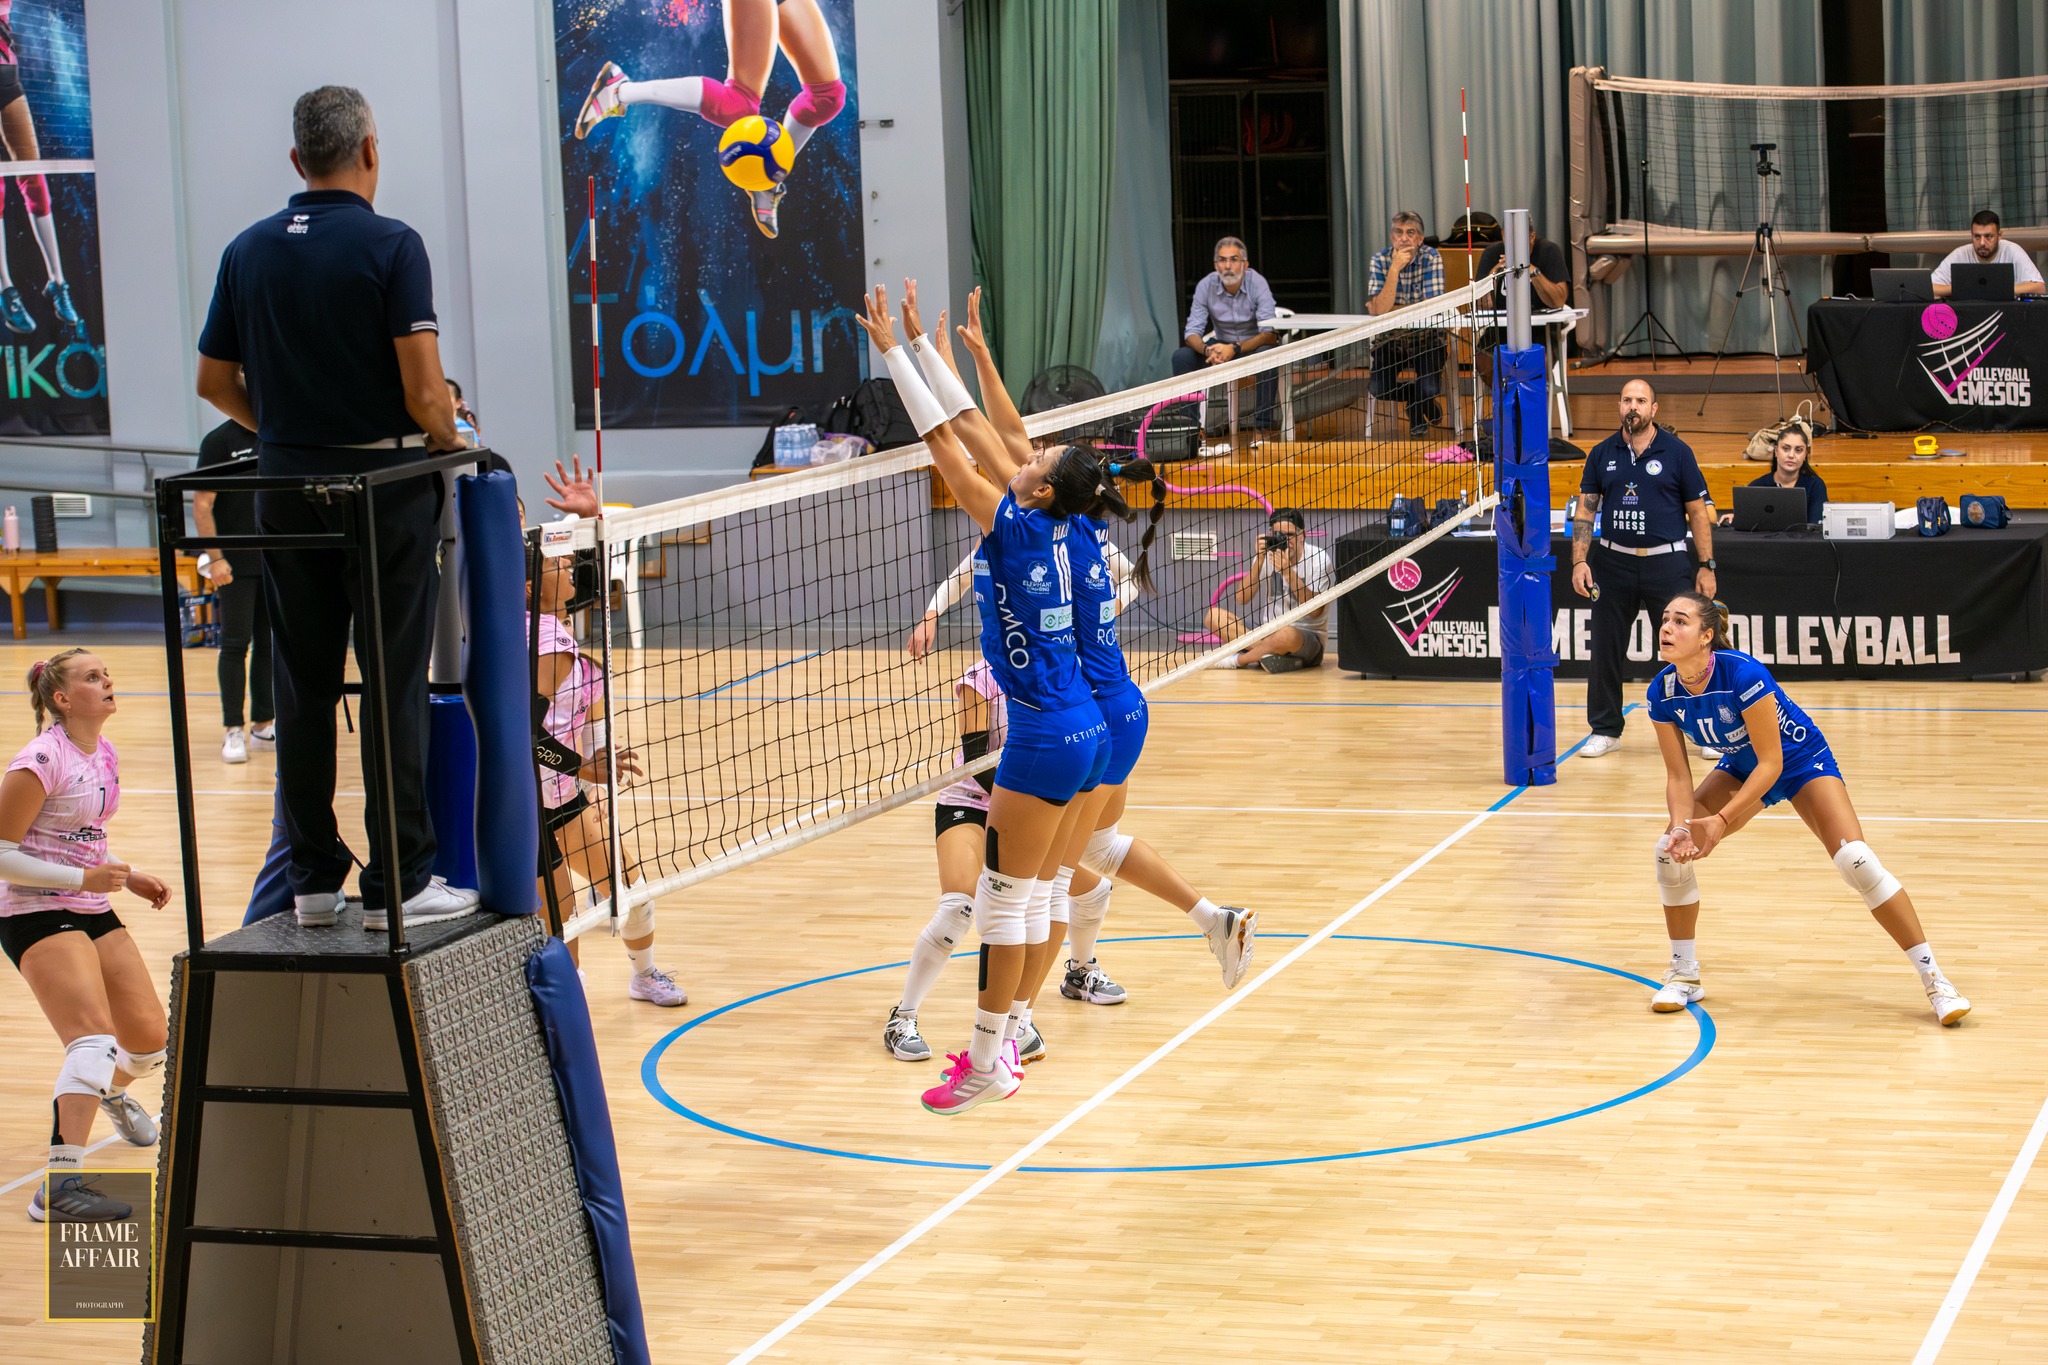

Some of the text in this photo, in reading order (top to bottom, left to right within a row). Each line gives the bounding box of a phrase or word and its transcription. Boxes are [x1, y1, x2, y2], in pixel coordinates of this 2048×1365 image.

[1967, 367, 2030, 382] VOLLEYBALL
[1613, 510, 1646, 521] PAFOS
[1613, 520, 1646, 531] PRESS
[1427, 621, 1487, 635] VOLLEYBALL
[1728, 614, 1961, 665] OLLEYBALL
[1697, 717, 1721, 744] 17
[99, 787, 105, 818] 7
[49, 1156, 78, 1164] adidas
